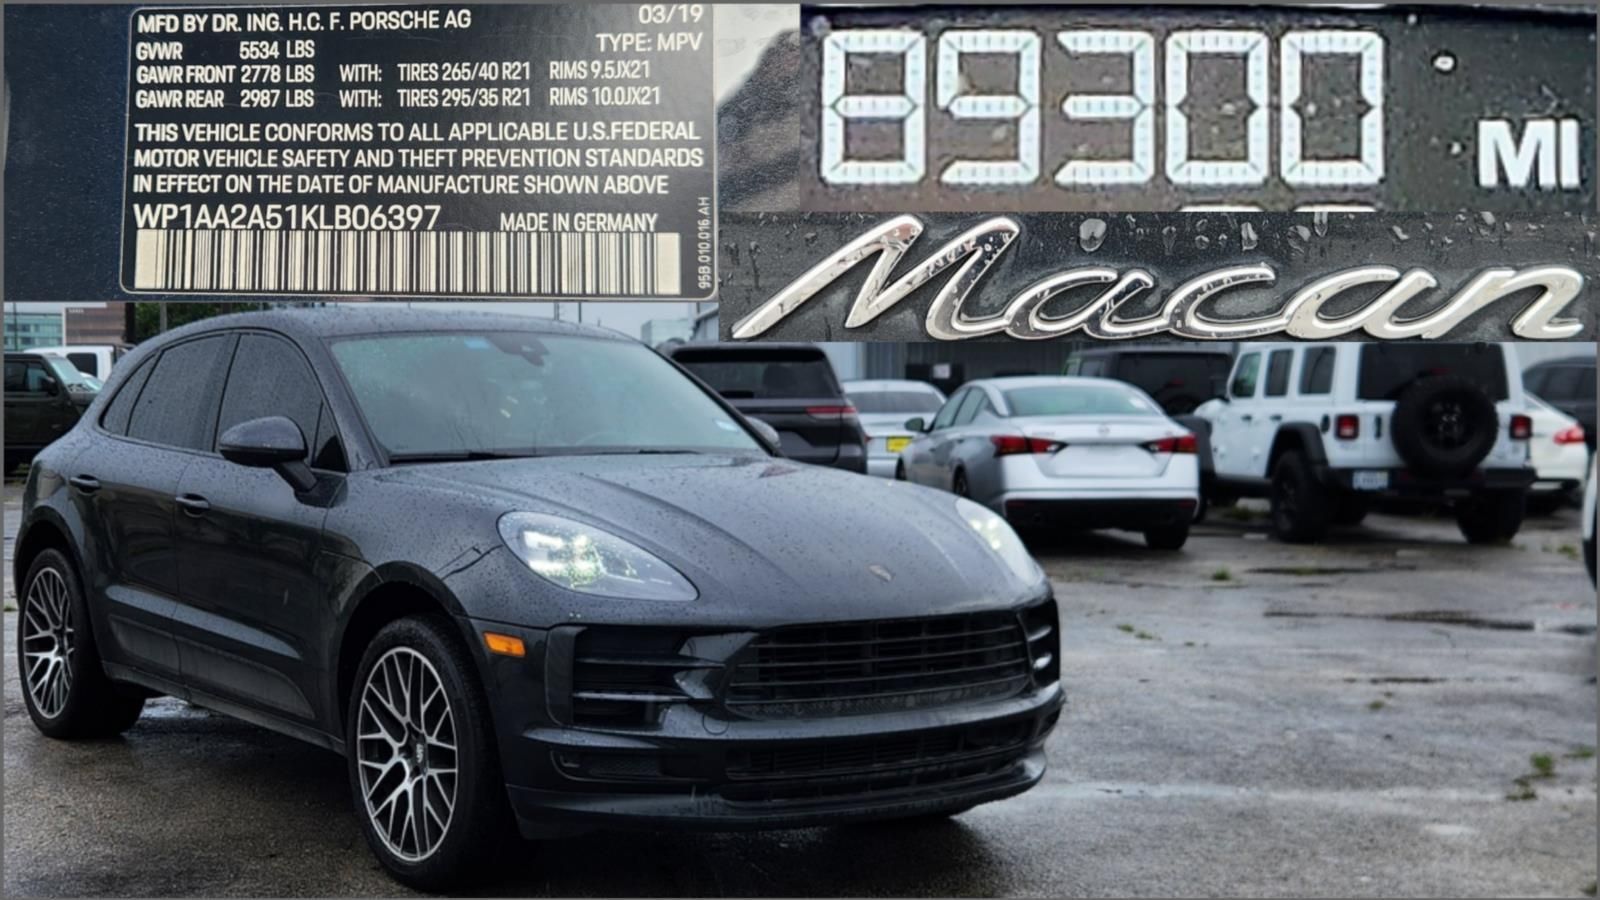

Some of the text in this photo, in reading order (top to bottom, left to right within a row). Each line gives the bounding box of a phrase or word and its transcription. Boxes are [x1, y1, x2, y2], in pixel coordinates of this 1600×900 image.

[137, 9, 472, 34] MFD BY DR. ING. H.C. F. PORSCHE AG
[638, 4, 704, 25] 03/19
[135, 40, 315, 61] GVWR 5534 LBS
[595, 32, 703, 52] TYPE: MPV
[135, 60, 650, 84] GAWR FRONT 2778 LBS WITH: TIRES 265/40 R21 RIMS 9.5JX21
[135, 86, 660, 109] GAWR REAR 2987 LBS WITH: TIRES 295/35 R21 RIMS 10.0JX21
[821, 29, 1580, 189] 89300 MI
[134, 121, 701, 142] THIS VEHICLE CONFORMS TO ALL APPLICABLE U.S.FEDERAL
[133, 148, 704, 169] MOTOR VEHICLE SAFETY AND THEFT PREVENTION STANDARDS
[133, 174, 669, 195] IN EFFECT ON THE DATE OF MANUFACTURE SHOWN ABOVE
[133, 203, 442, 231] WP1AA2A51KLB06397
[499, 212, 659, 232] MADE IN GERMANY
[732, 214, 1584, 341] Macan
